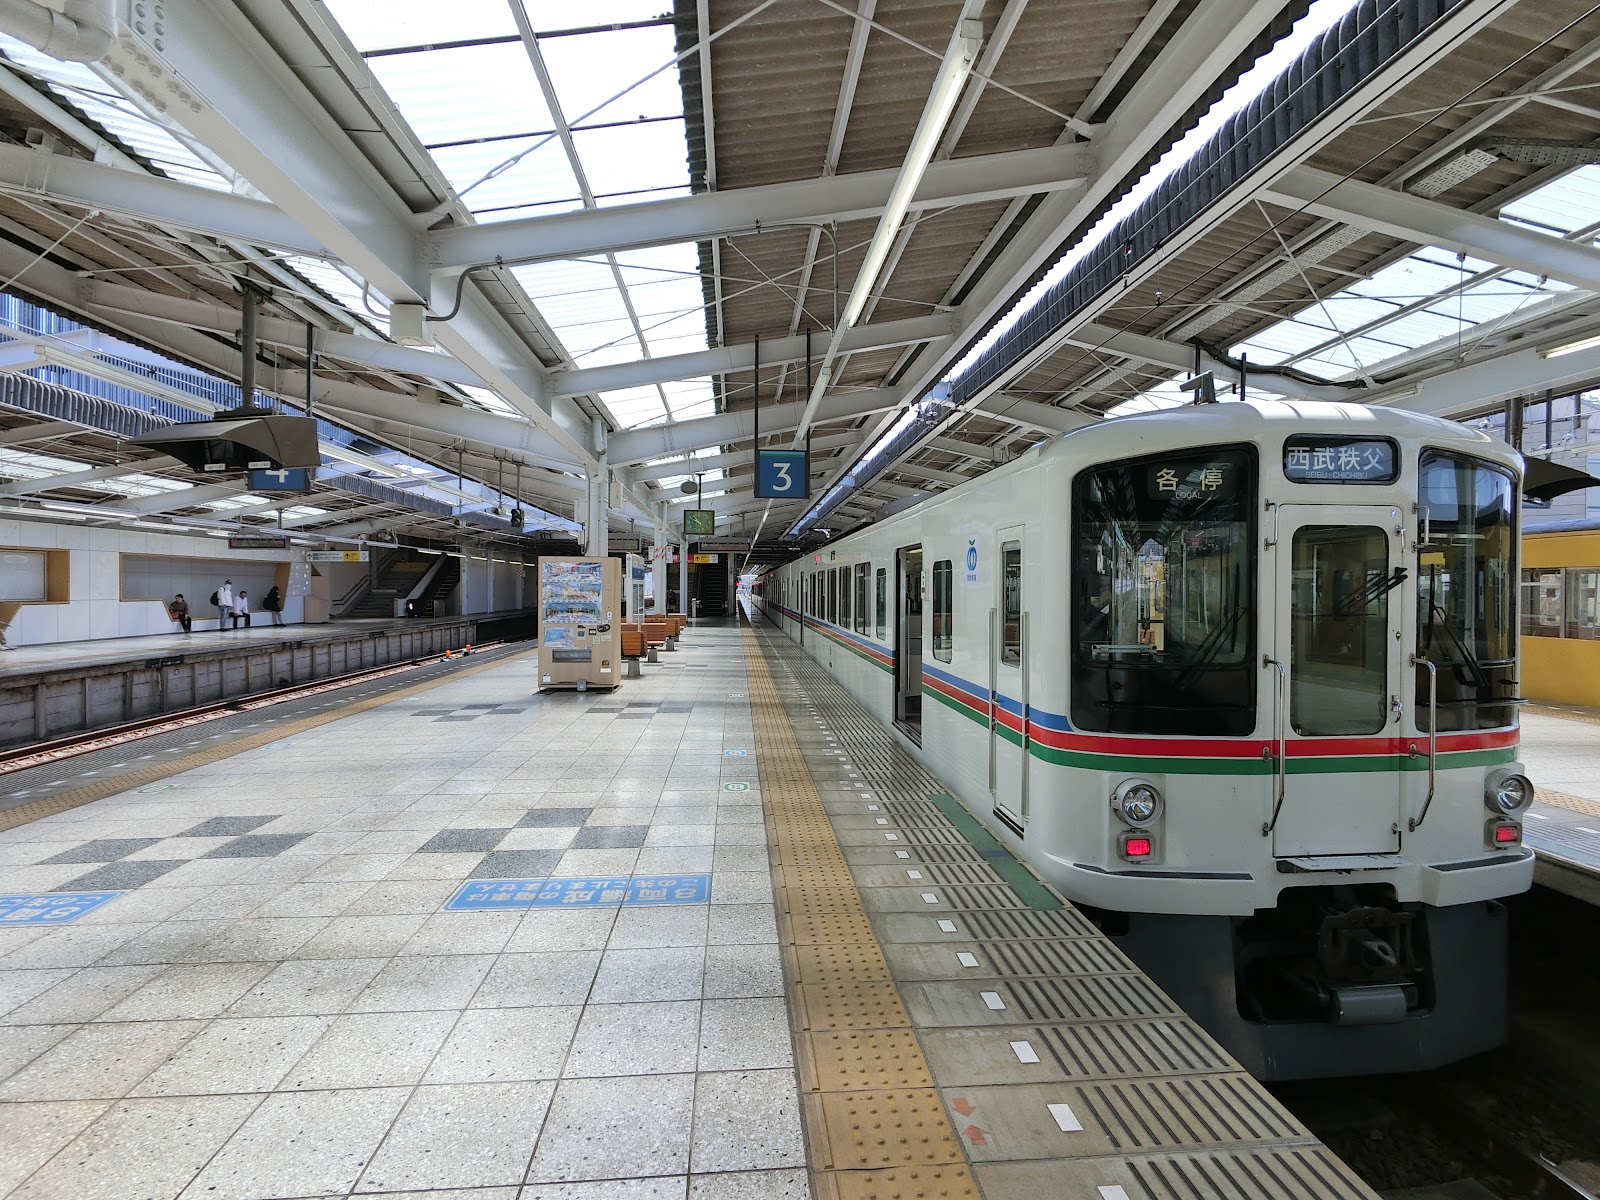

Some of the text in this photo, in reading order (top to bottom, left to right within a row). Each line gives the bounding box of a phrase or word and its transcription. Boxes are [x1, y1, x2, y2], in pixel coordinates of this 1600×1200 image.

[1287, 446, 1385, 471] 西武秩父
[772, 462, 792, 491] 3
[1175, 491, 1202, 499] LOCAL
[475, 879, 698, 893] この先に止まりません
[465, 888, 697, 904] 8両編成の電車は
